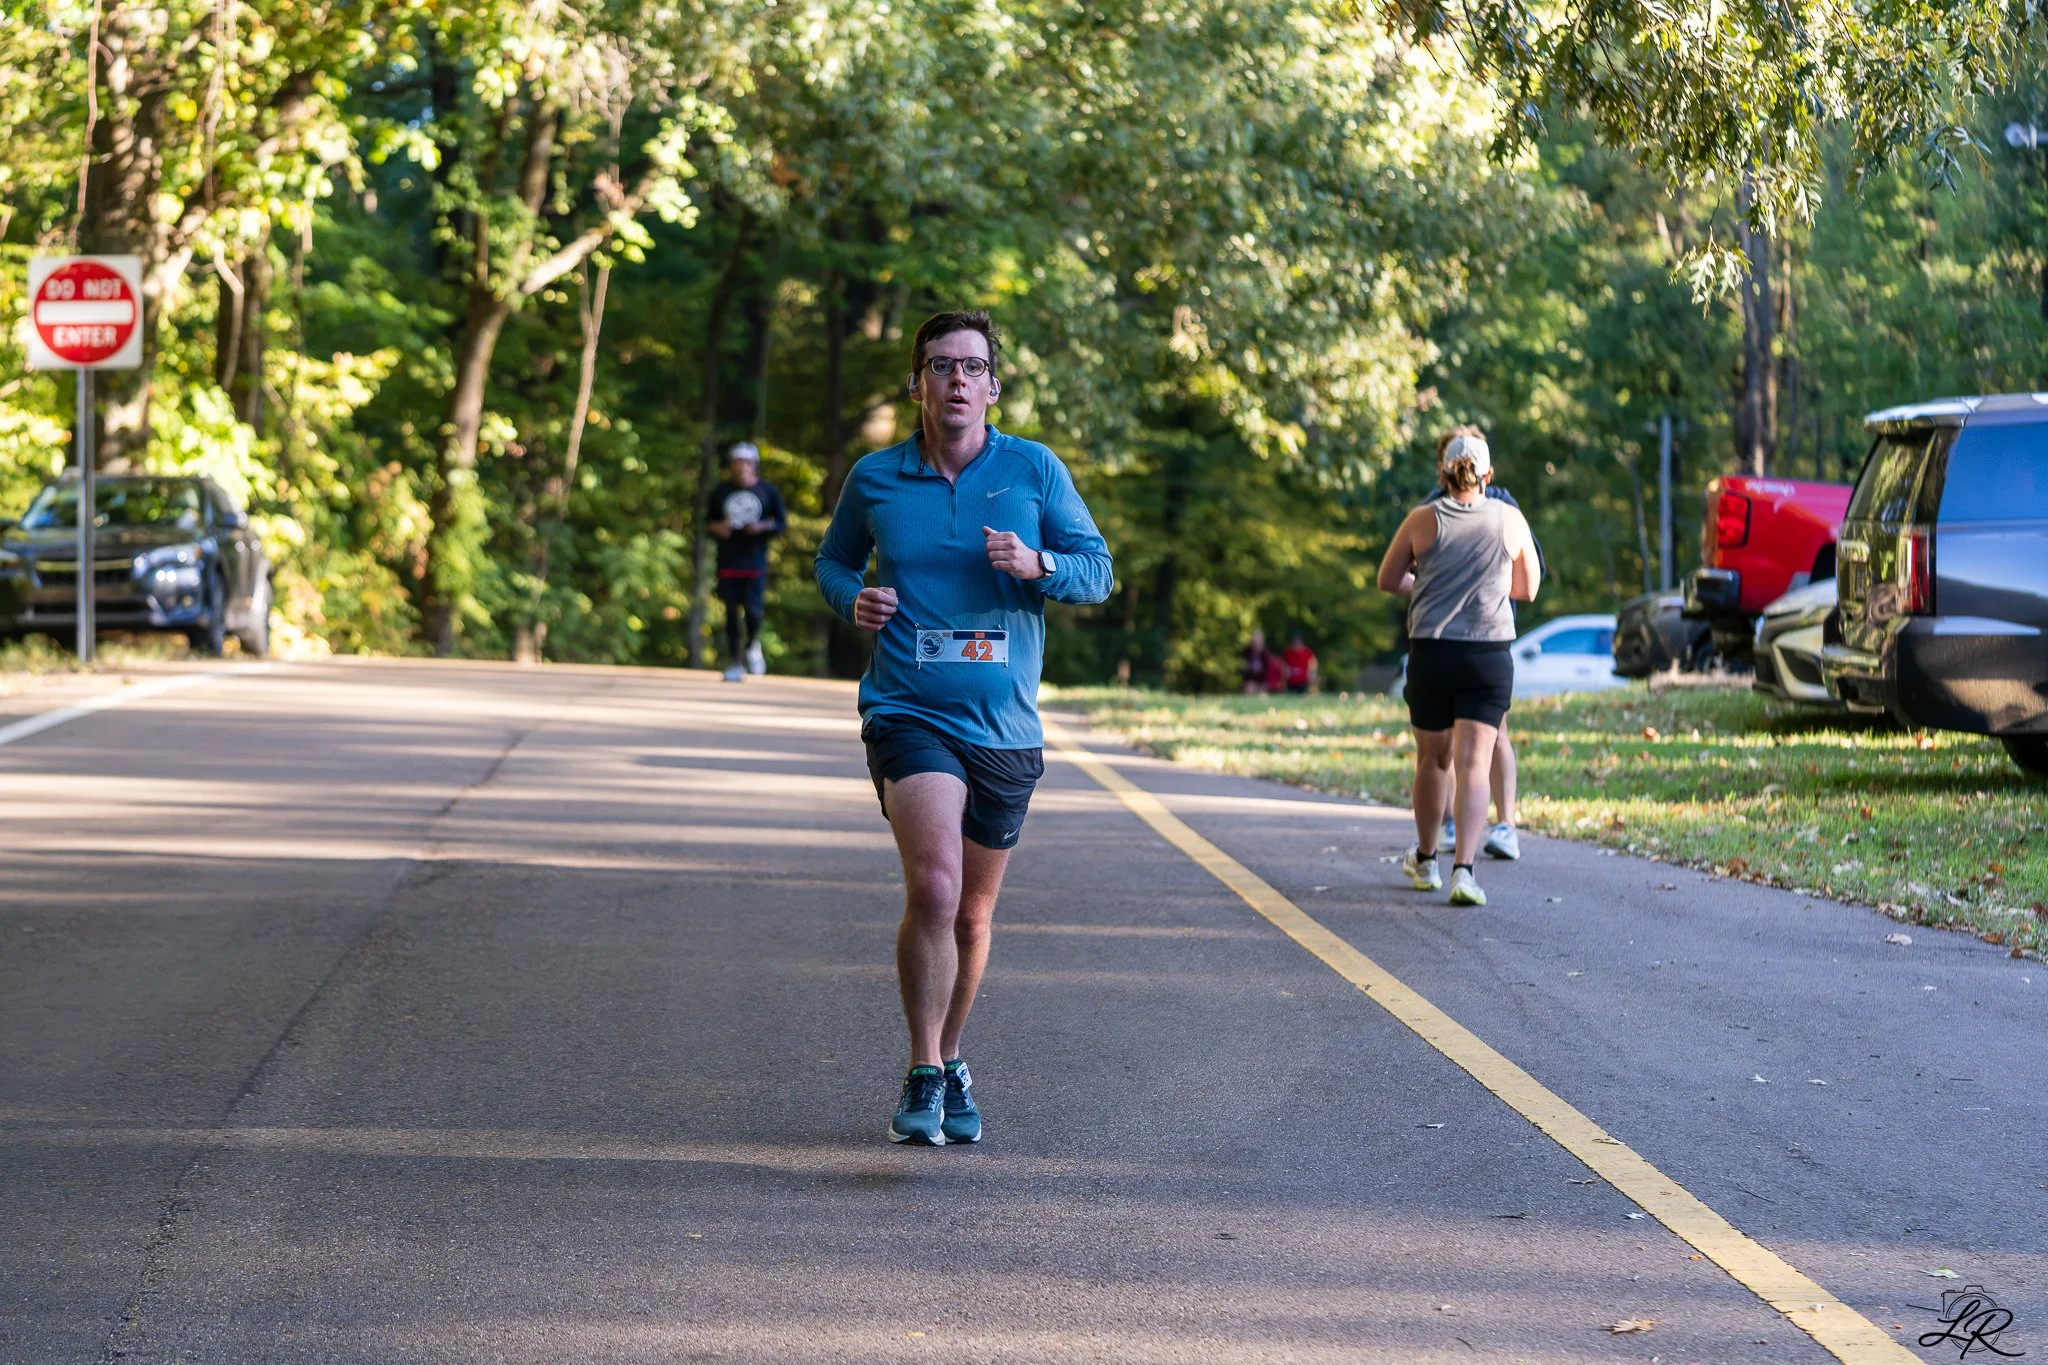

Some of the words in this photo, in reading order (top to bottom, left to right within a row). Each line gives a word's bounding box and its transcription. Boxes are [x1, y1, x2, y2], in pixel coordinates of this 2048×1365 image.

[45, 278, 76, 299] DO
[82, 278, 122, 299] NOT
[52, 326, 117, 348] ENTER
[961, 640, 993, 661] 42
